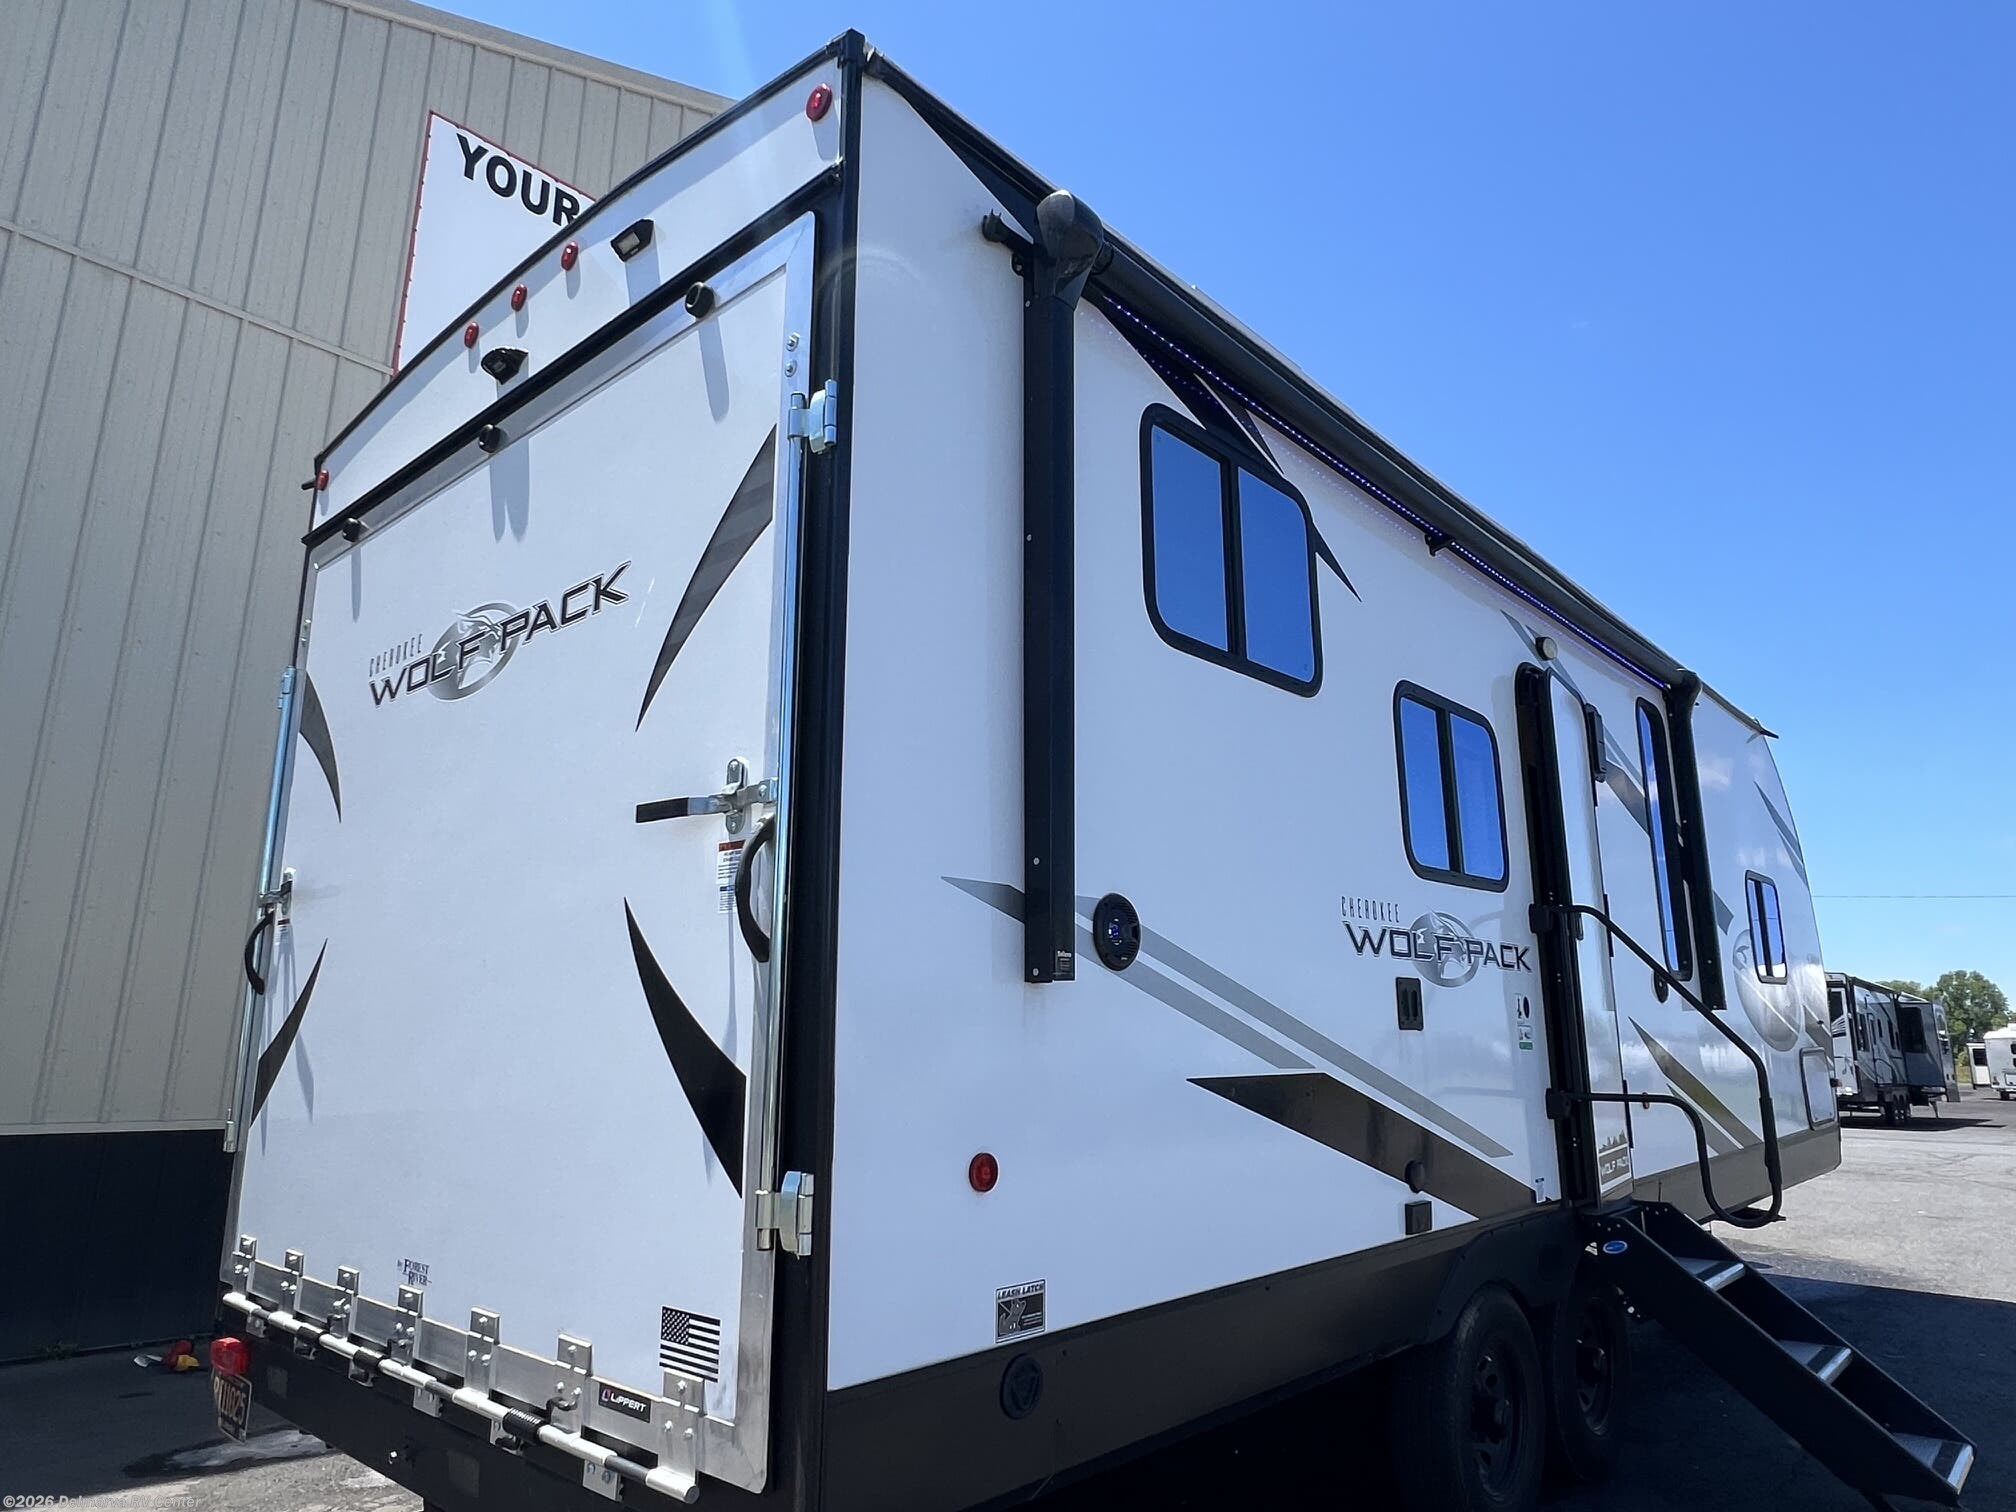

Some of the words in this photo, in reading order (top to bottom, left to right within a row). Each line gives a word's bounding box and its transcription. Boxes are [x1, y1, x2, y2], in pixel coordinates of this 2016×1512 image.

[456, 132, 580, 226] YOUR
[369, 630, 489, 708] WOLF
[498, 561, 631, 655] PACK
[1341, 895, 1400, 923] CHEROKEE
[1342, 920, 1455, 962] WOLF
[1463, 937, 1532, 973] PACK
